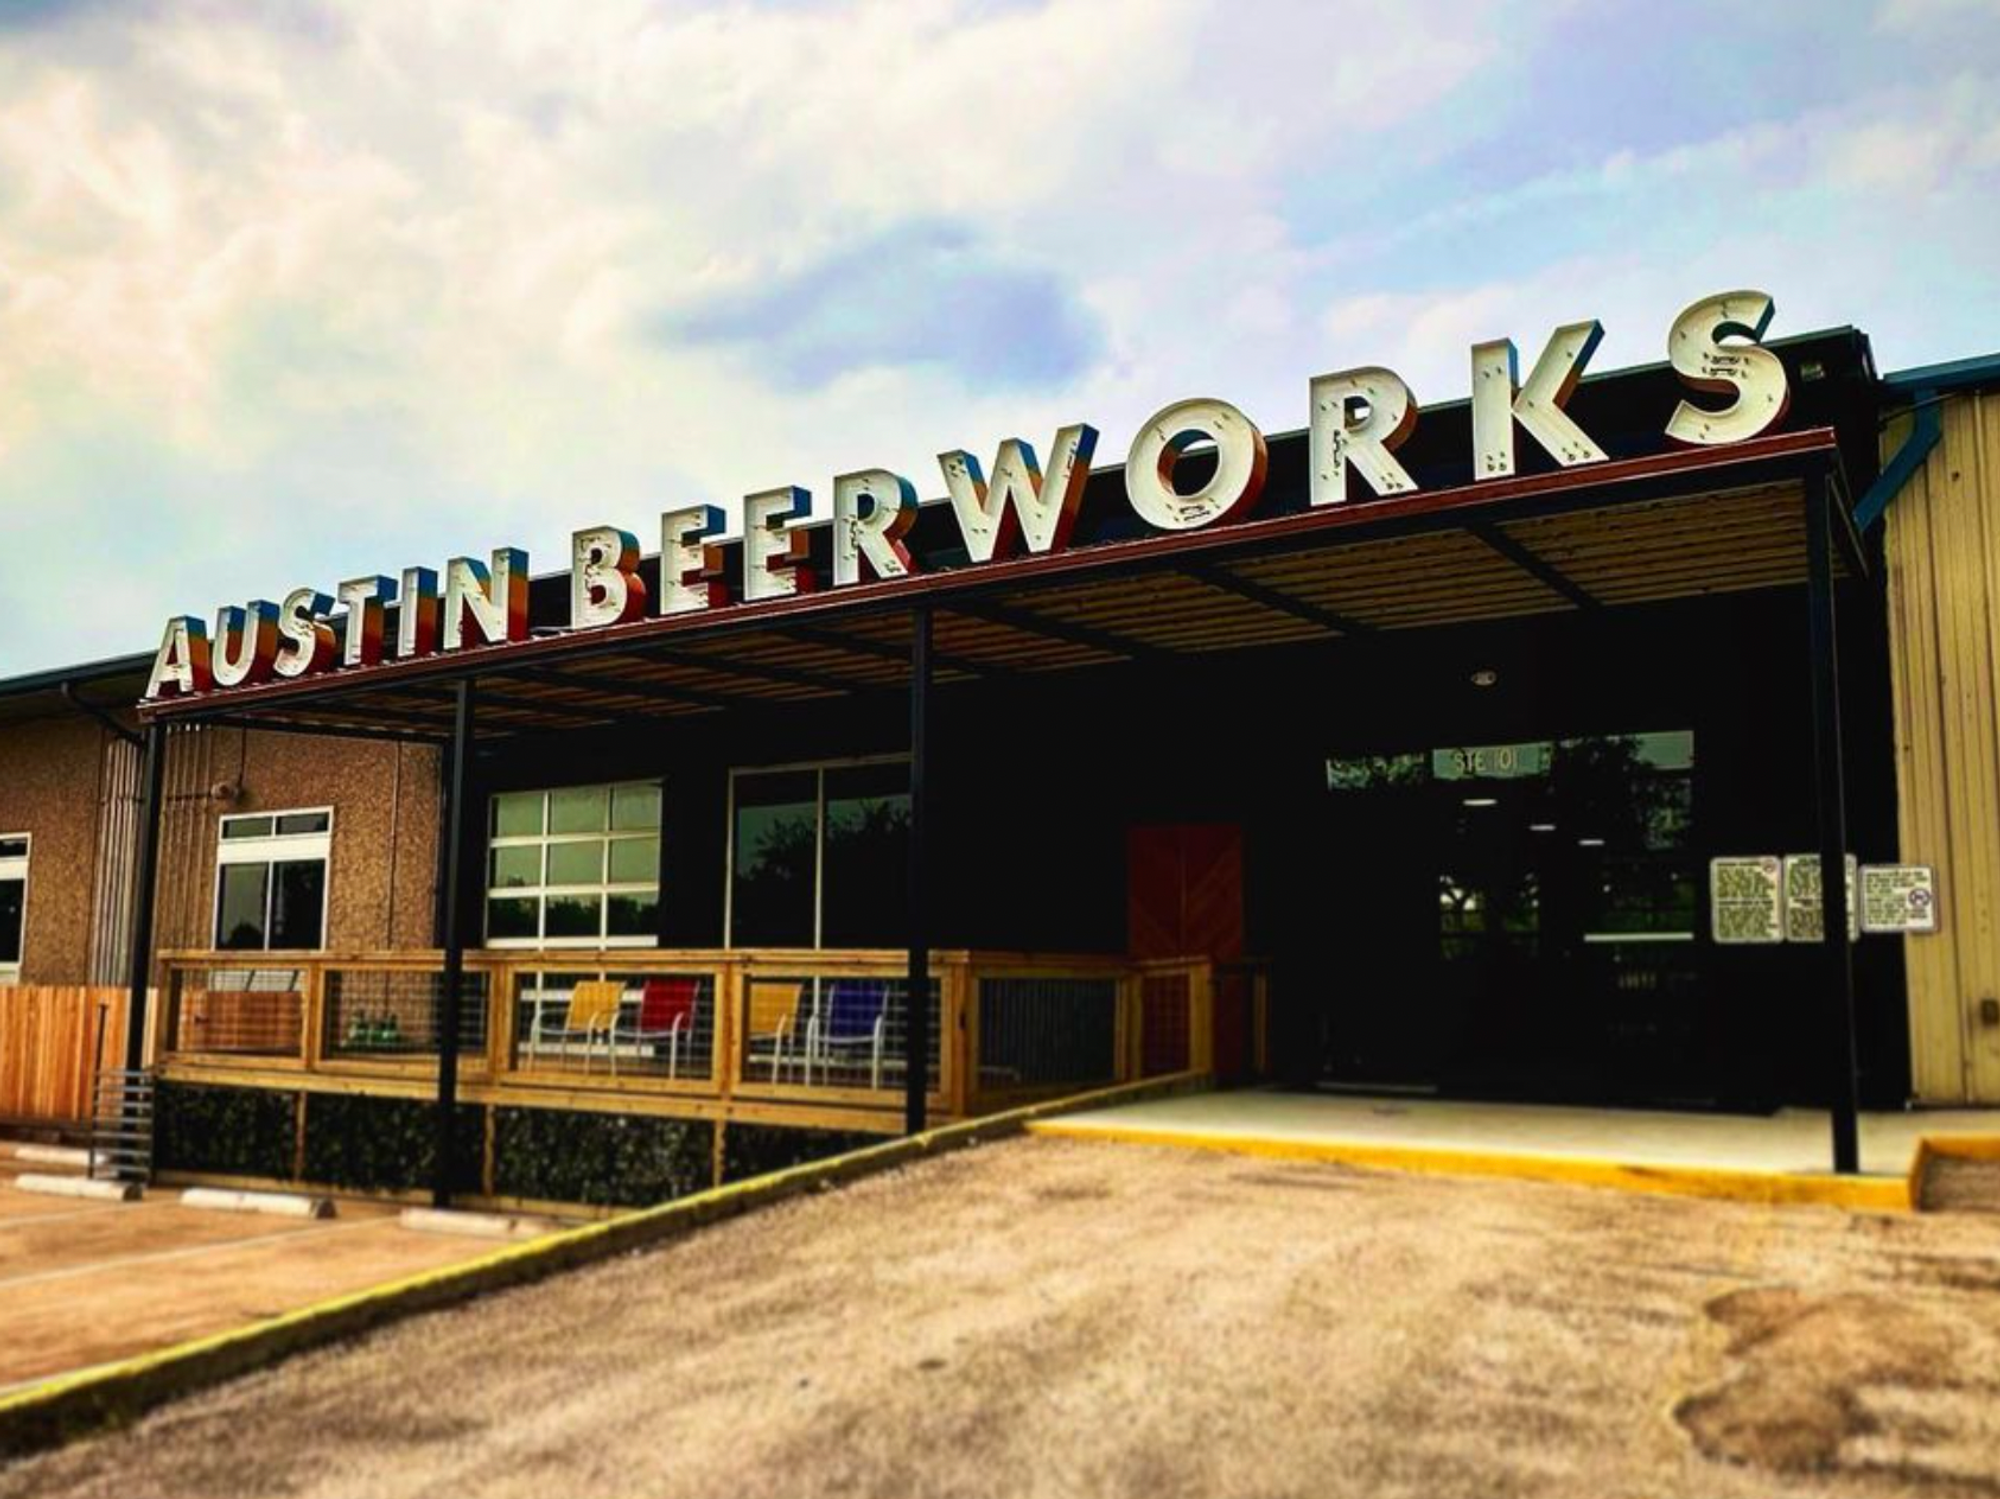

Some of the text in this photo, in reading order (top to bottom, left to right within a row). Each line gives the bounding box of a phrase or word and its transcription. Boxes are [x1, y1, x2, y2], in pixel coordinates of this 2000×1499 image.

[145, 289, 1790, 698] AUSTIN BEERWORKS
[1453, 749, 1487, 773] STE
